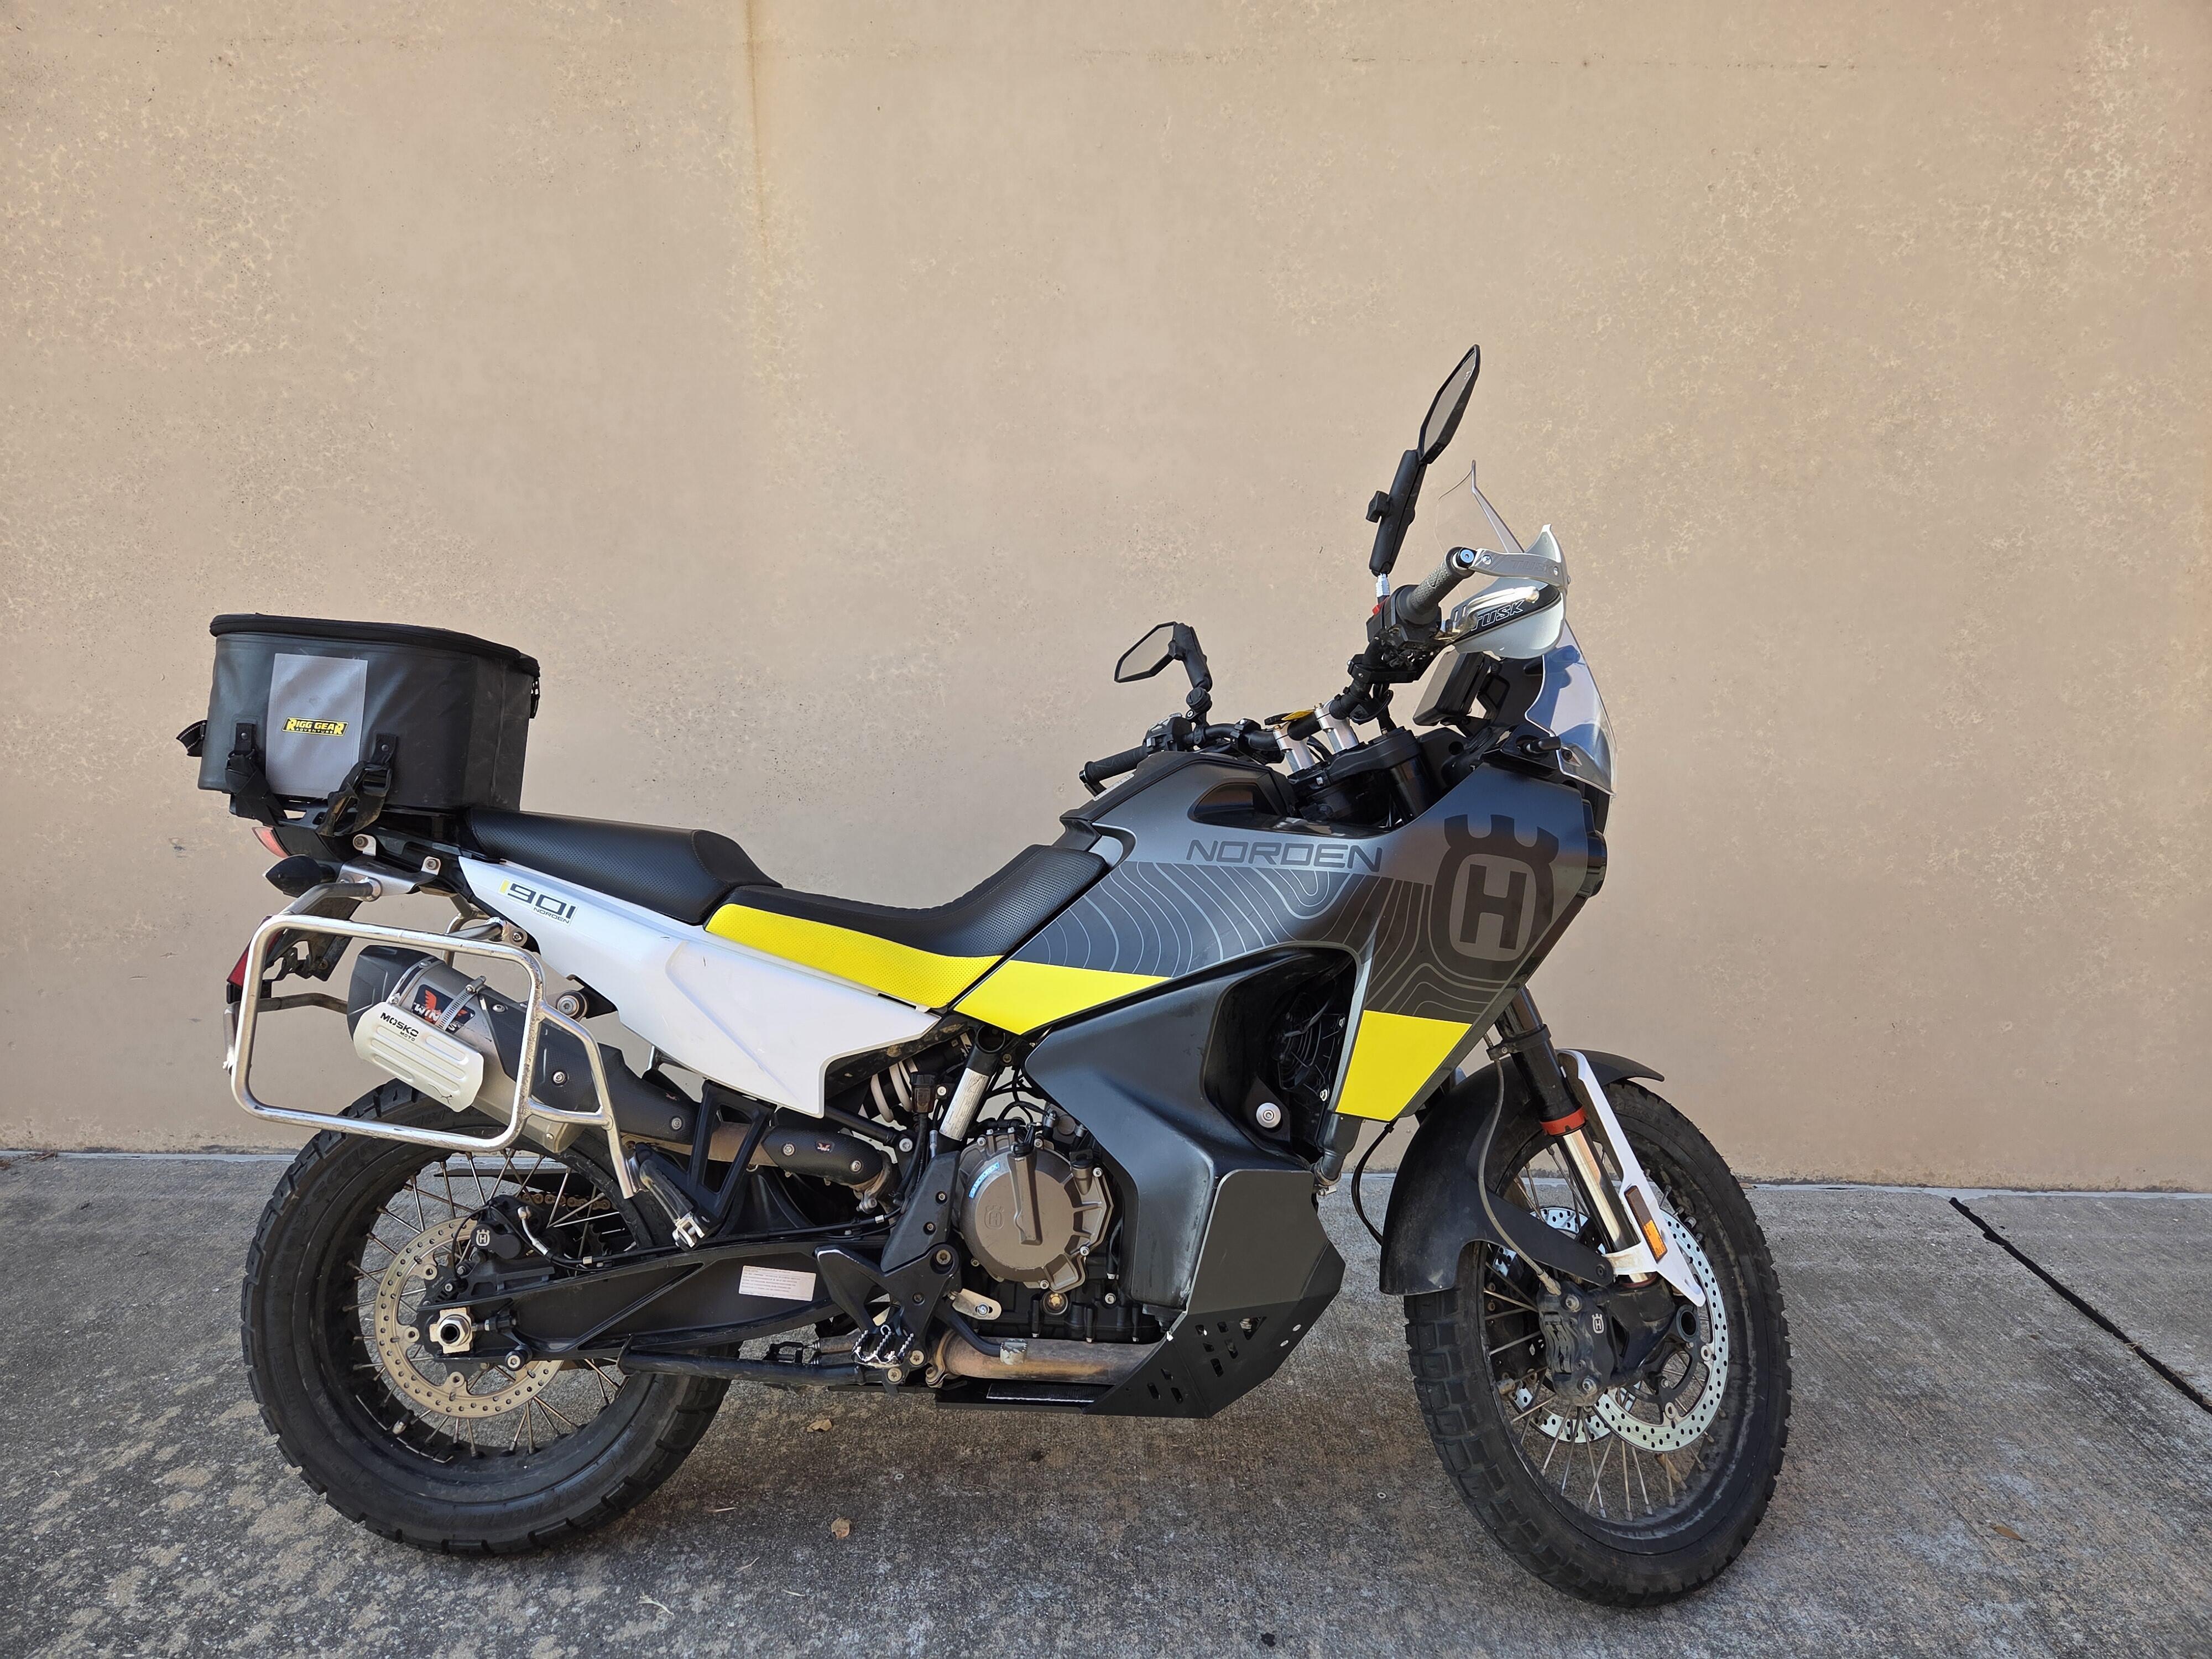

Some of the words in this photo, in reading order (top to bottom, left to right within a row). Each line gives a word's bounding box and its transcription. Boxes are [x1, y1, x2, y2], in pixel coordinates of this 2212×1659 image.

[1471, 599, 1525, 632] TUSK
[286, 719, 313, 731] RIGG
[314, 722, 345, 735] GEAR
[1186, 839, 1383, 872] NORDEN
[508, 883, 576, 919] 901
[534, 907, 570, 924] NORDEN
[380, 1012, 419, 1037] MOSKO
[414, 1003, 457, 1031] WINS
[399, 1031, 416, 1041] MOTO
